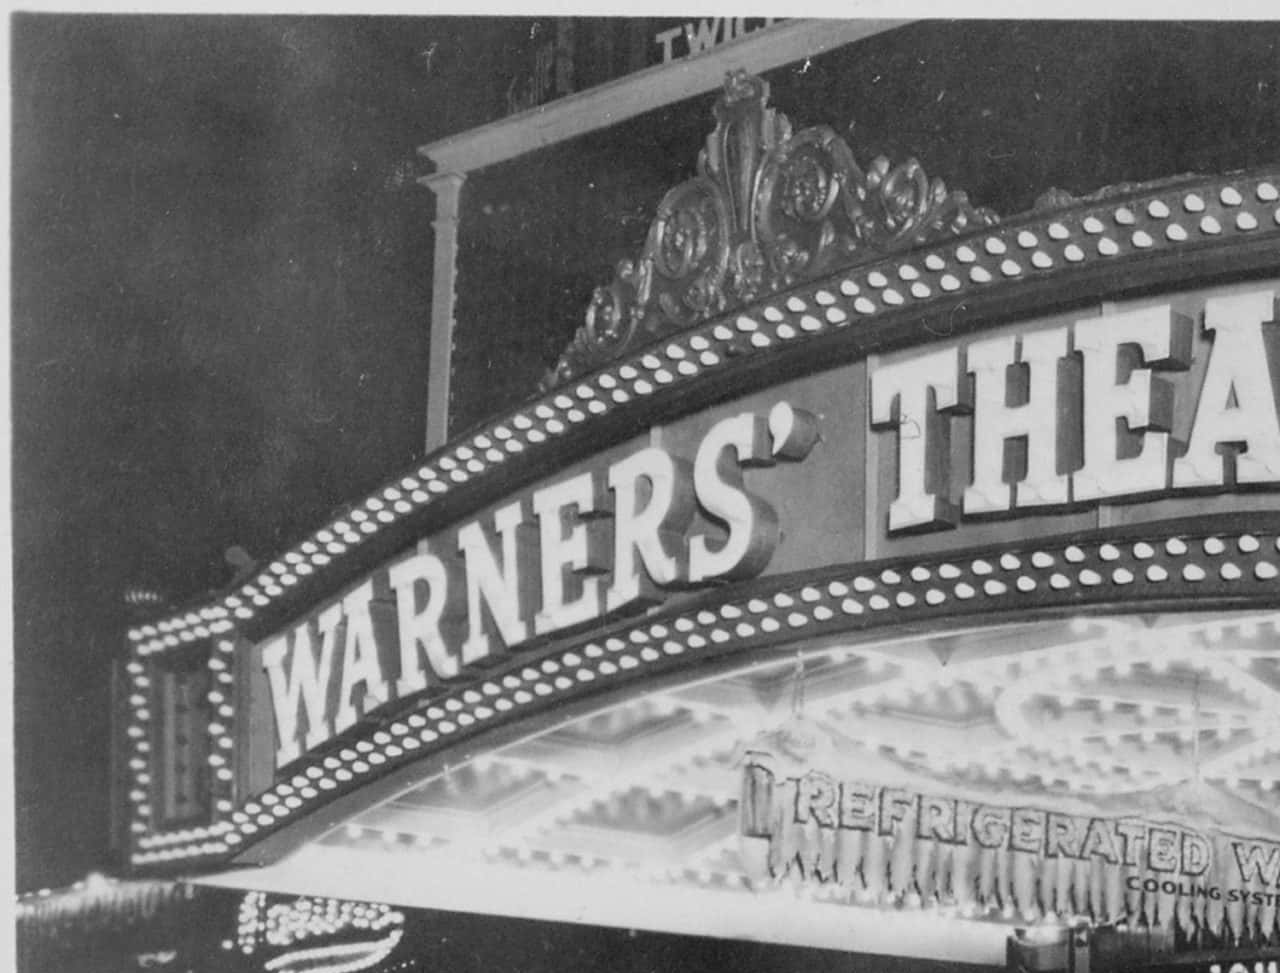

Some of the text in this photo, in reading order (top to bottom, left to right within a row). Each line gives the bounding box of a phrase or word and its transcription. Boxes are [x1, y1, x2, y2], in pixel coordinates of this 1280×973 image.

[261, 400, 794, 769] WARNERS'
[787, 768, 1213, 877] REFRIGERATED
[1126, 875, 1222, 901] COOLING
